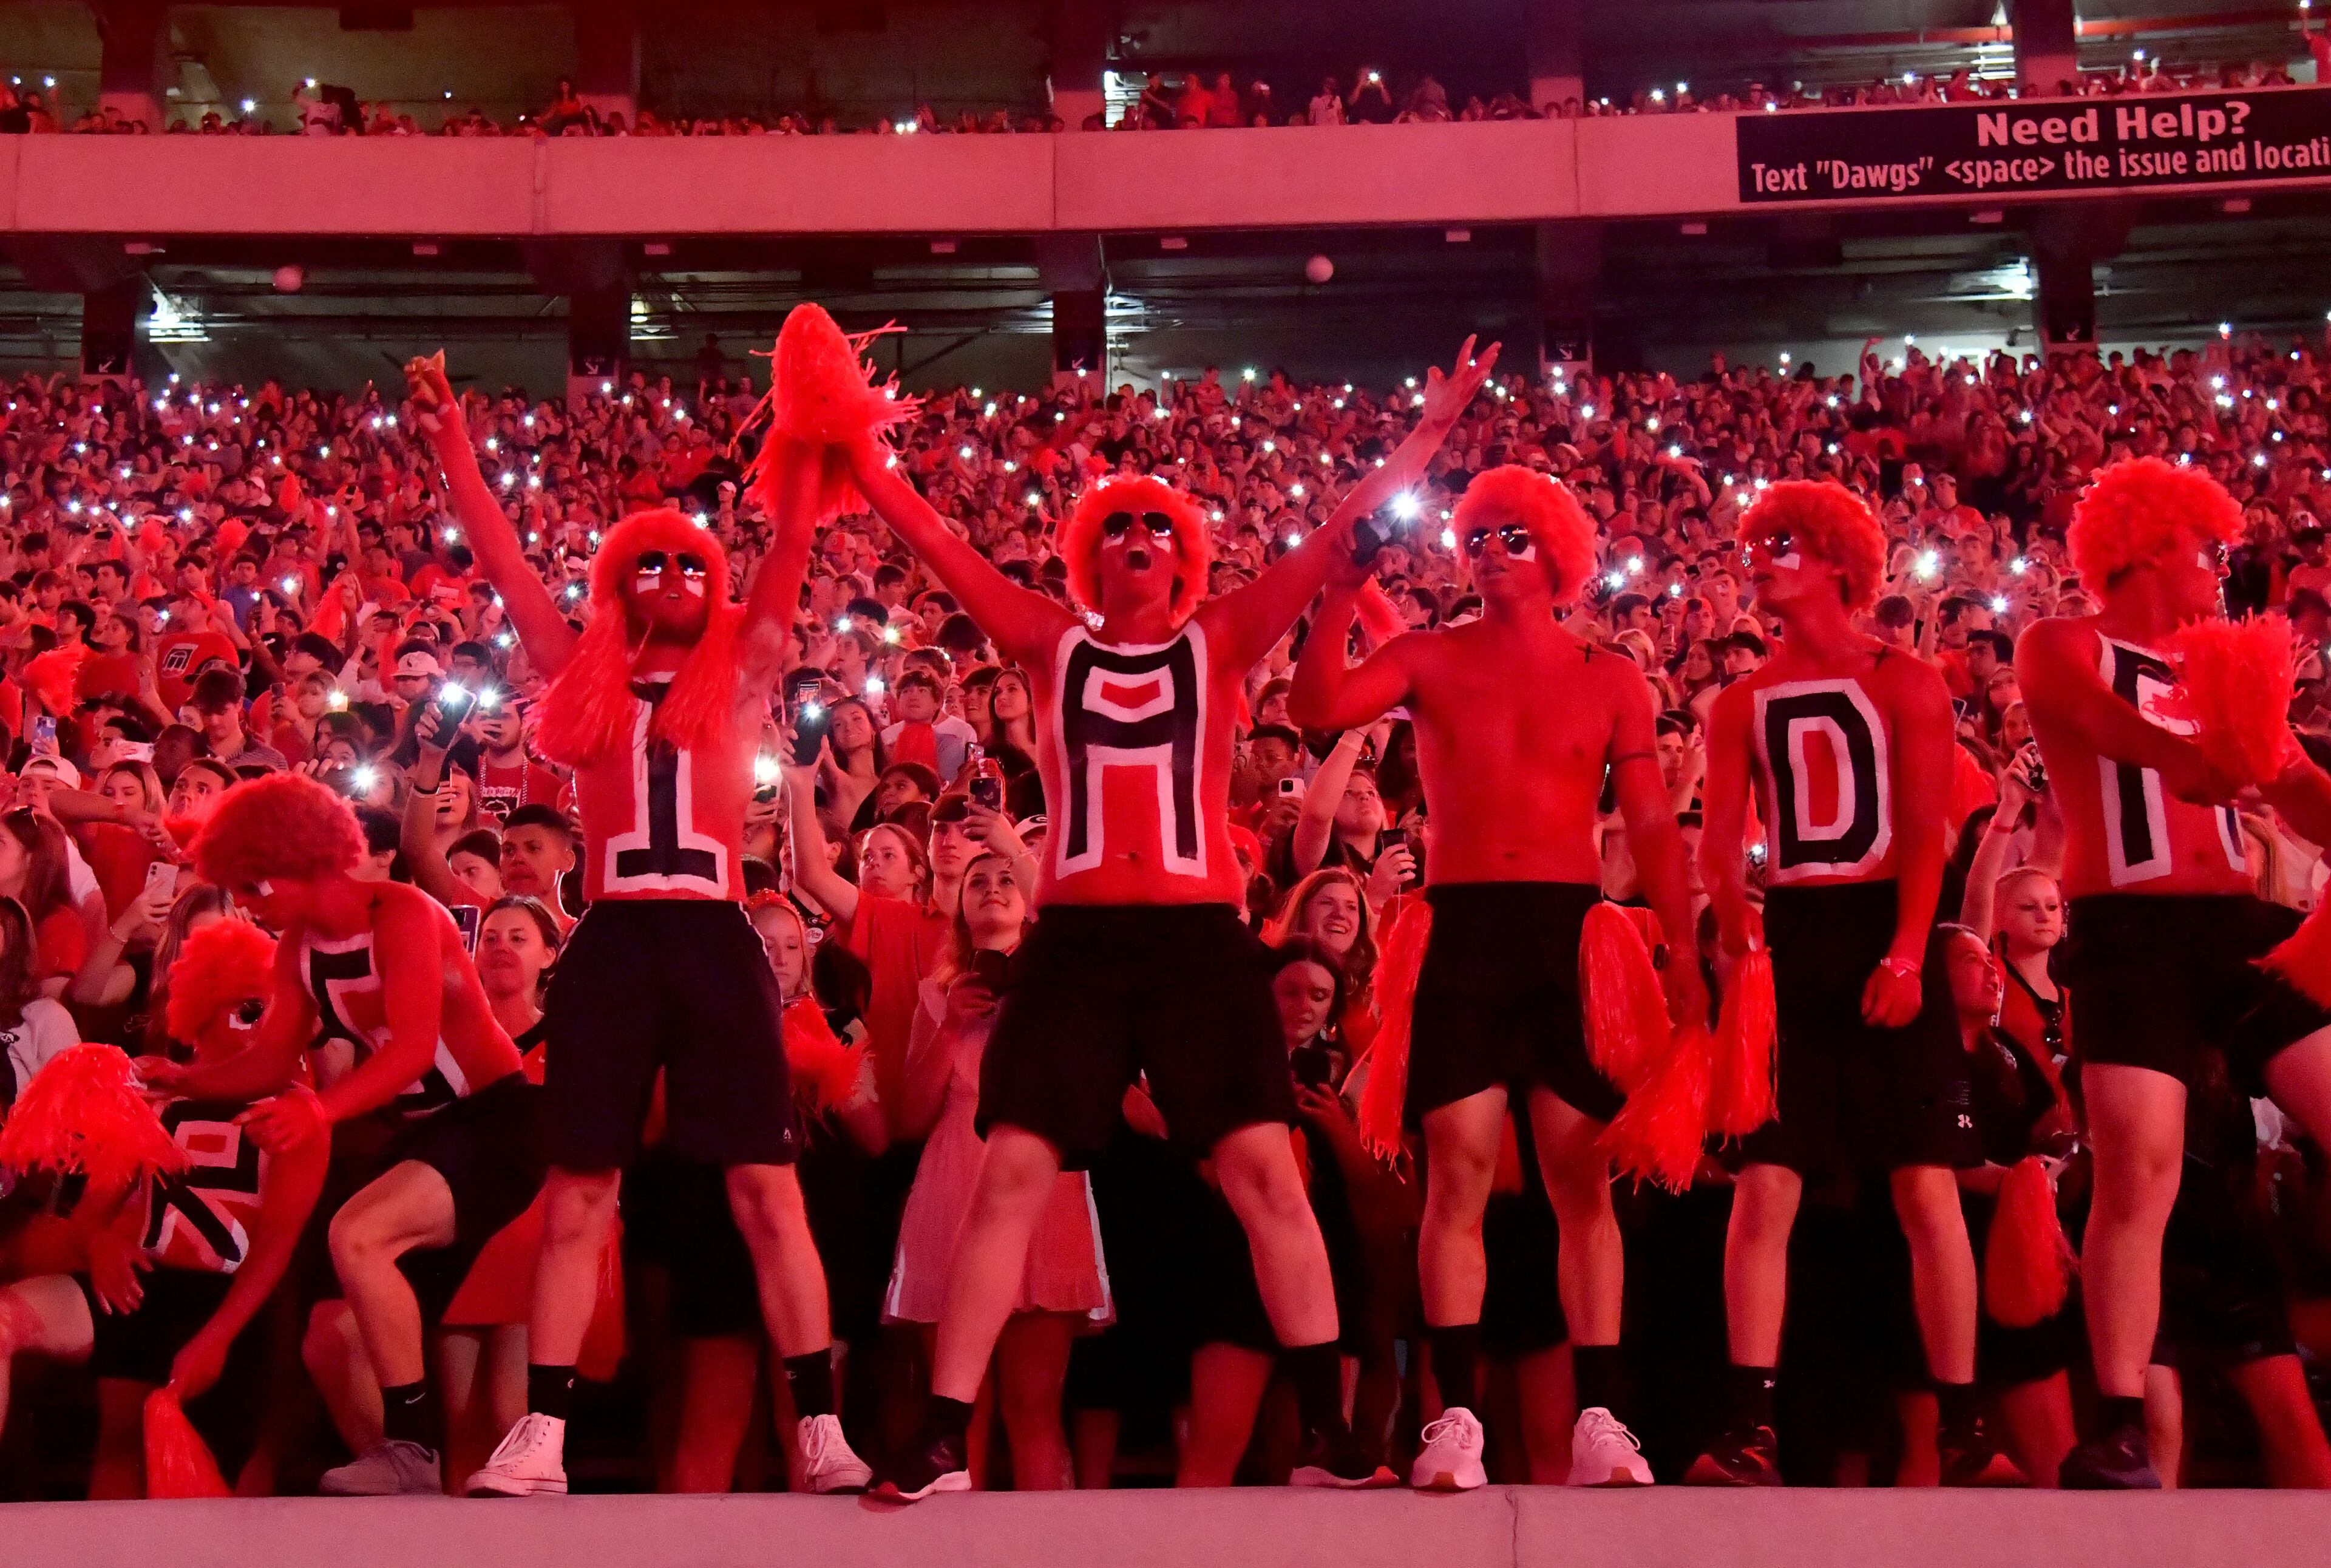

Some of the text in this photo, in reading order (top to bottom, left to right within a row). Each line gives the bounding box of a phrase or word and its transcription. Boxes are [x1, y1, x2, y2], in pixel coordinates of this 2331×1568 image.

[1751, 136, 2331, 192] Text "Dawgs" <space> the issue and locati
[1976, 101, 2251, 147] Need Help?
[603, 671, 728, 897] I
[1054, 620, 1207, 880] A
[1754, 678, 1892, 883] D
